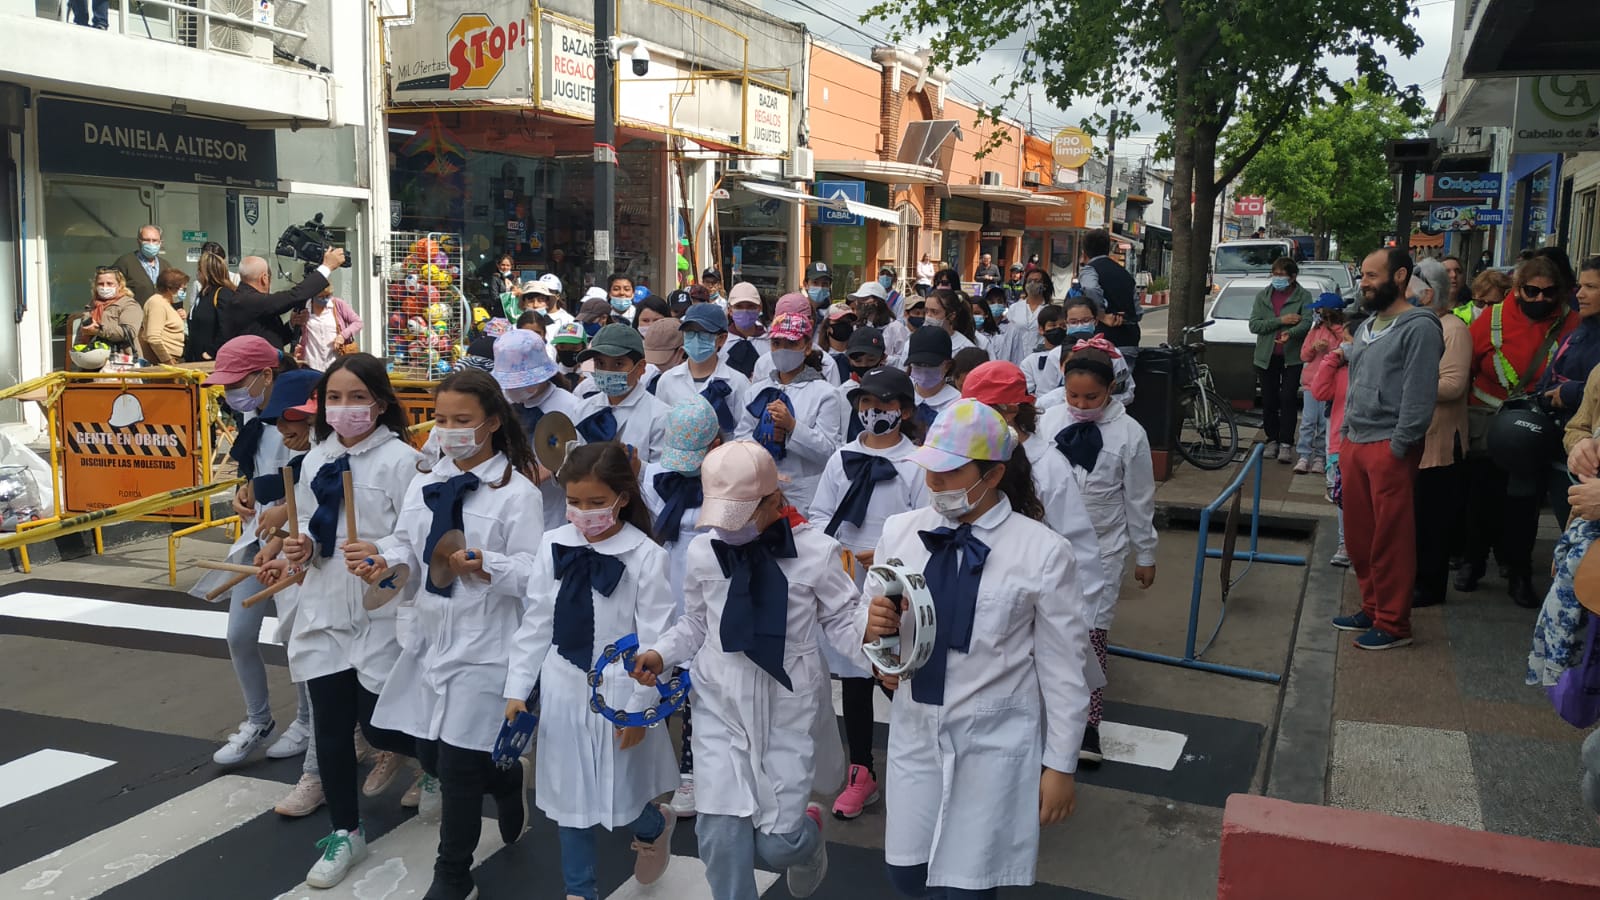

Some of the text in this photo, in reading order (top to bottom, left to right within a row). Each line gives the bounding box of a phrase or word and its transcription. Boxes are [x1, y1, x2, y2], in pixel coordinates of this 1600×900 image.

[449, 18, 526, 91] STOP!
[562, 35, 595, 59] BAZAR
[413, 57, 447, 76] Ofertas
[554, 55, 596, 80] REGALO
[554, 78, 596, 103] JUGUETE
[759, 93, 778, 109] BAZAR
[754, 109, 781, 127] REGALOS
[84, 122, 169, 153] DANIELA
[174, 135, 248, 162] ALTESOR
[753, 127, 781, 144] JUGUETES
[1055, 136, 1080, 146] PRO
[1518, 128, 1563, 139] Cabello
[1566, 128, 1583, 138] de
[826, 211, 852, 219] CABAL
[76, 431, 178, 447] GENTE EN OBRAS
[80, 457, 176, 470] DISCULPE LAS MOLESTIAS
